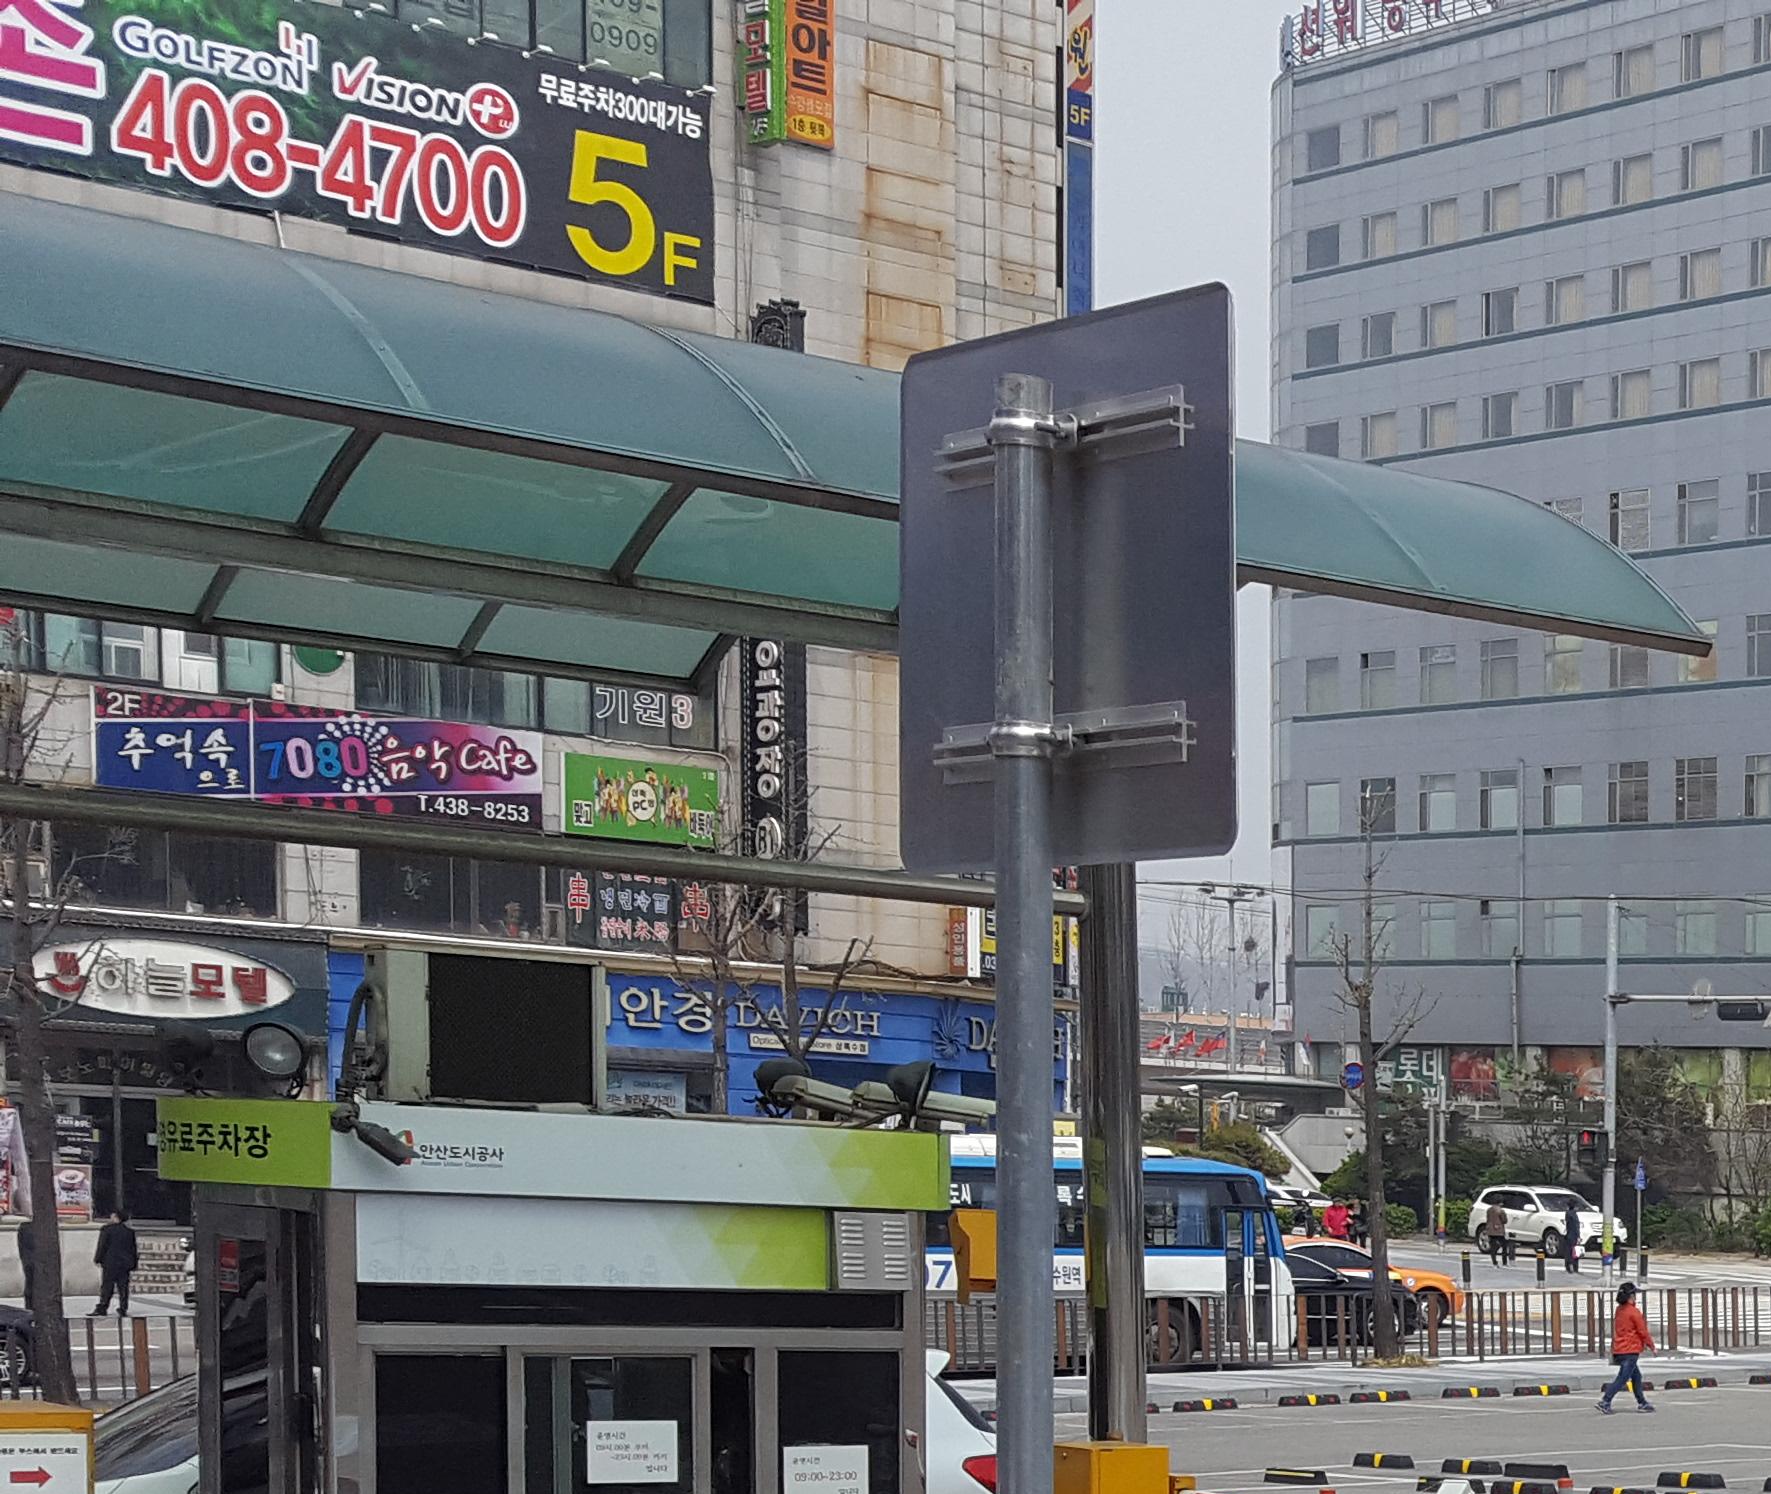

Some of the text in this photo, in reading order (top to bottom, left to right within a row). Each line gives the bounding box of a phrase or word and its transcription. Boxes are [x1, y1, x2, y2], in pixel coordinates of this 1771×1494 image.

[590, 21, 658, 54] 0909
[335, 57, 465, 126] VISION
[538, 72, 703, 140] 무료주차300대가능
[1069, 105, 1091, 127] 5F
[113, 70, 525, 247] 408-4700
[106, 691, 143, 718] 2F
[118, 727, 236, 772] 추억속
[258, 734, 538, 784] 7080 음악 Cafe
[418, 794, 531, 824] T.438-8253
[96, 954, 269, 1006] 하늘모텔
[736, 1002, 881, 1037] DAVICH
[419, 1143, 505, 1162] 안산도시공사
